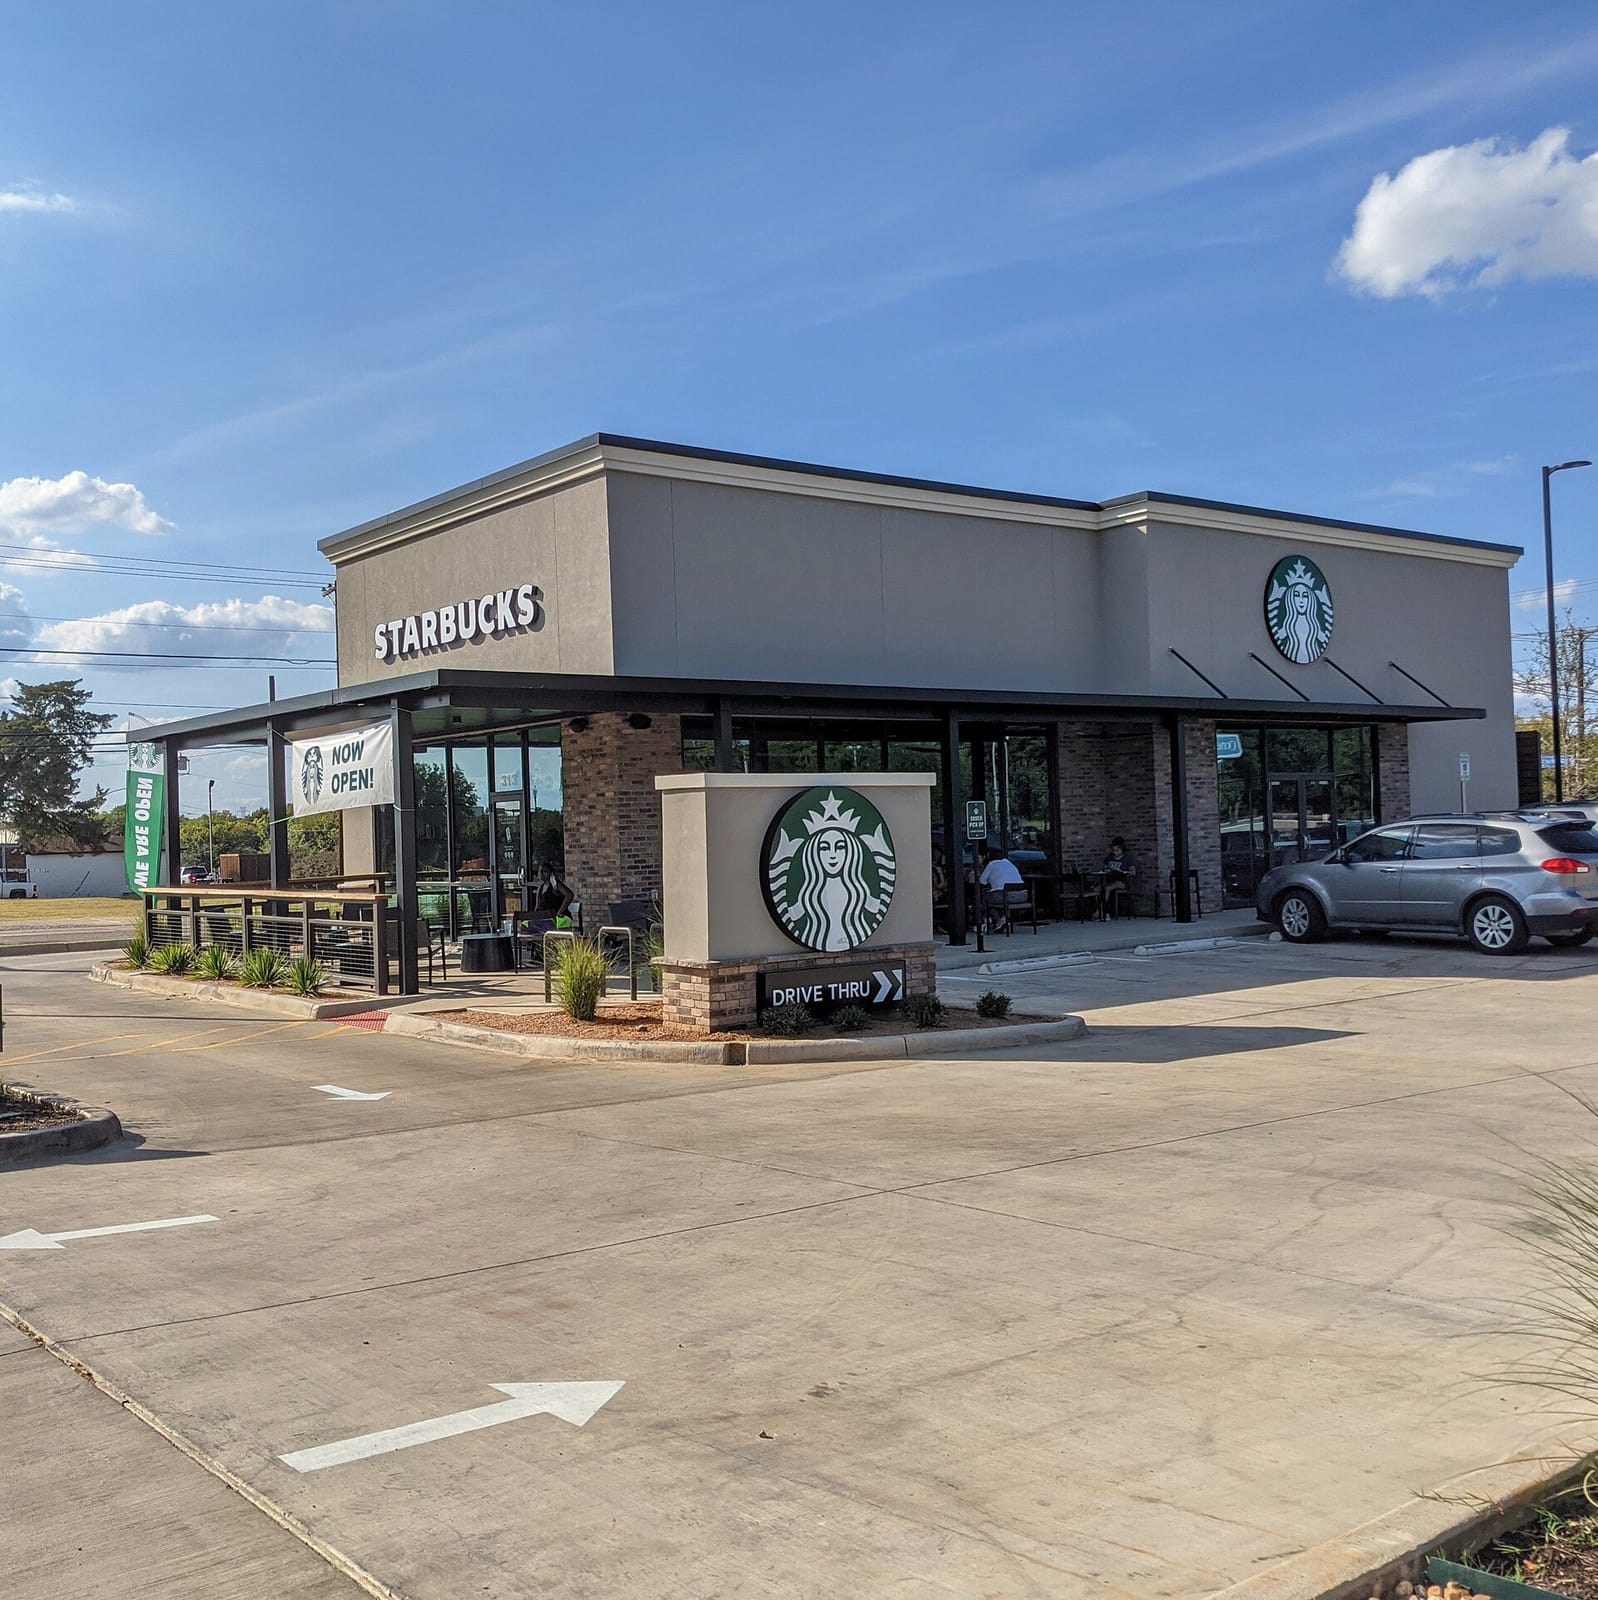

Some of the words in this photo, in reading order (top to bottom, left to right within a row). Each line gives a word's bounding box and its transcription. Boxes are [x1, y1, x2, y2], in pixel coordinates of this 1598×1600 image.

[374, 584, 536, 660] STARBUCKS
[331, 740, 365, 766] NOW
[331, 767, 374, 794] OPEN!
[501, 774, 517, 786] 313
[772, 985, 823, 1006] DRIVE
[828, 980, 871, 1000] THRU
